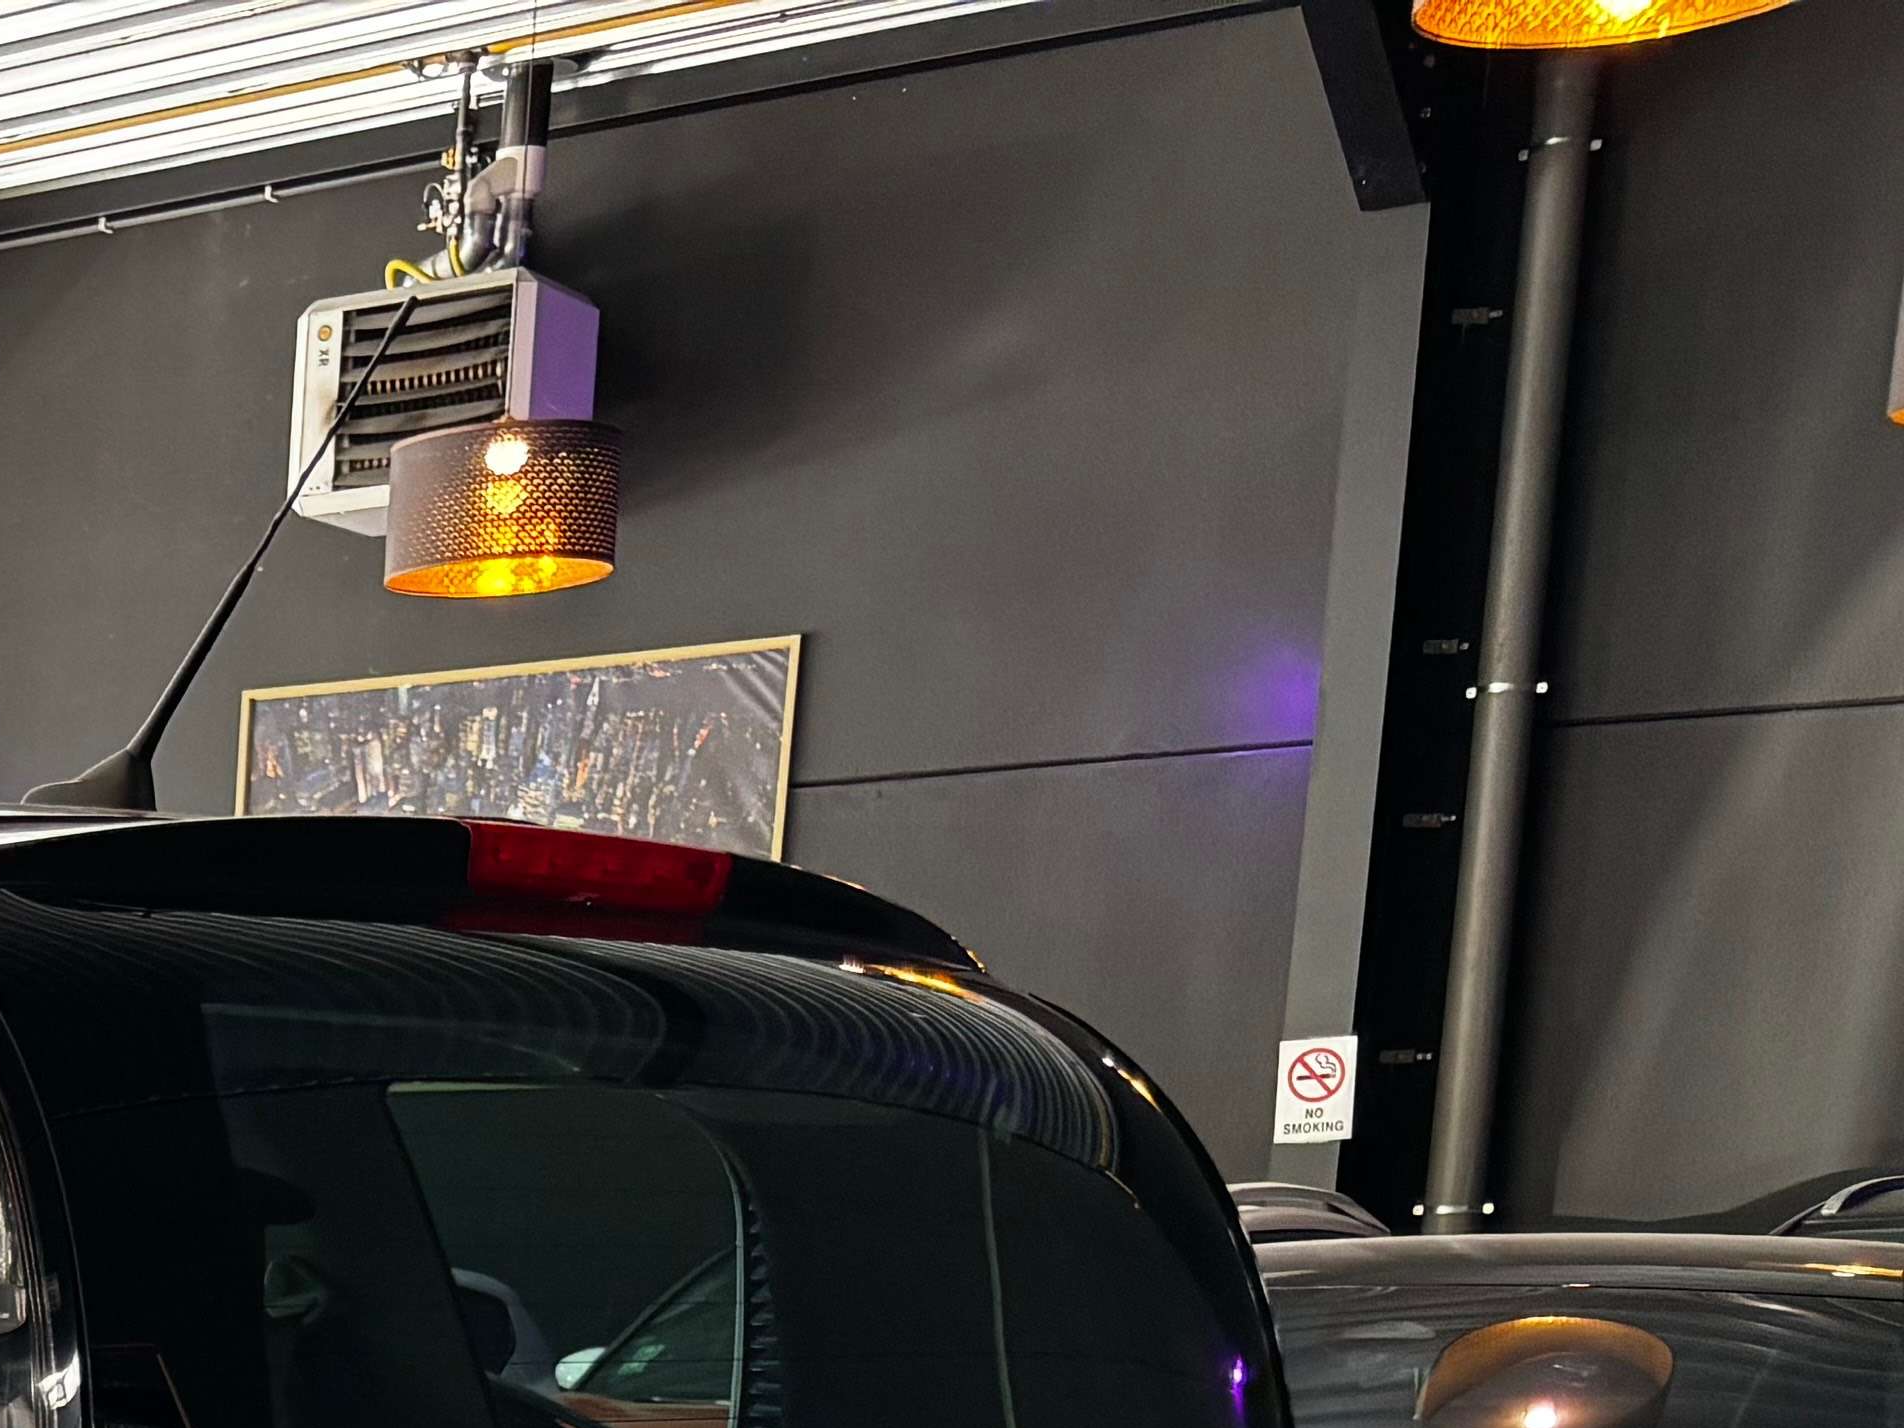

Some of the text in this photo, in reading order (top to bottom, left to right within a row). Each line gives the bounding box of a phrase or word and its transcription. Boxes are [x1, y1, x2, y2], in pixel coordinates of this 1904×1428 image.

[318, 349, 330, 367] XR
[1304, 1108, 1324, 1119] NO
[1283, 1120, 1344, 1135] SMOKING
